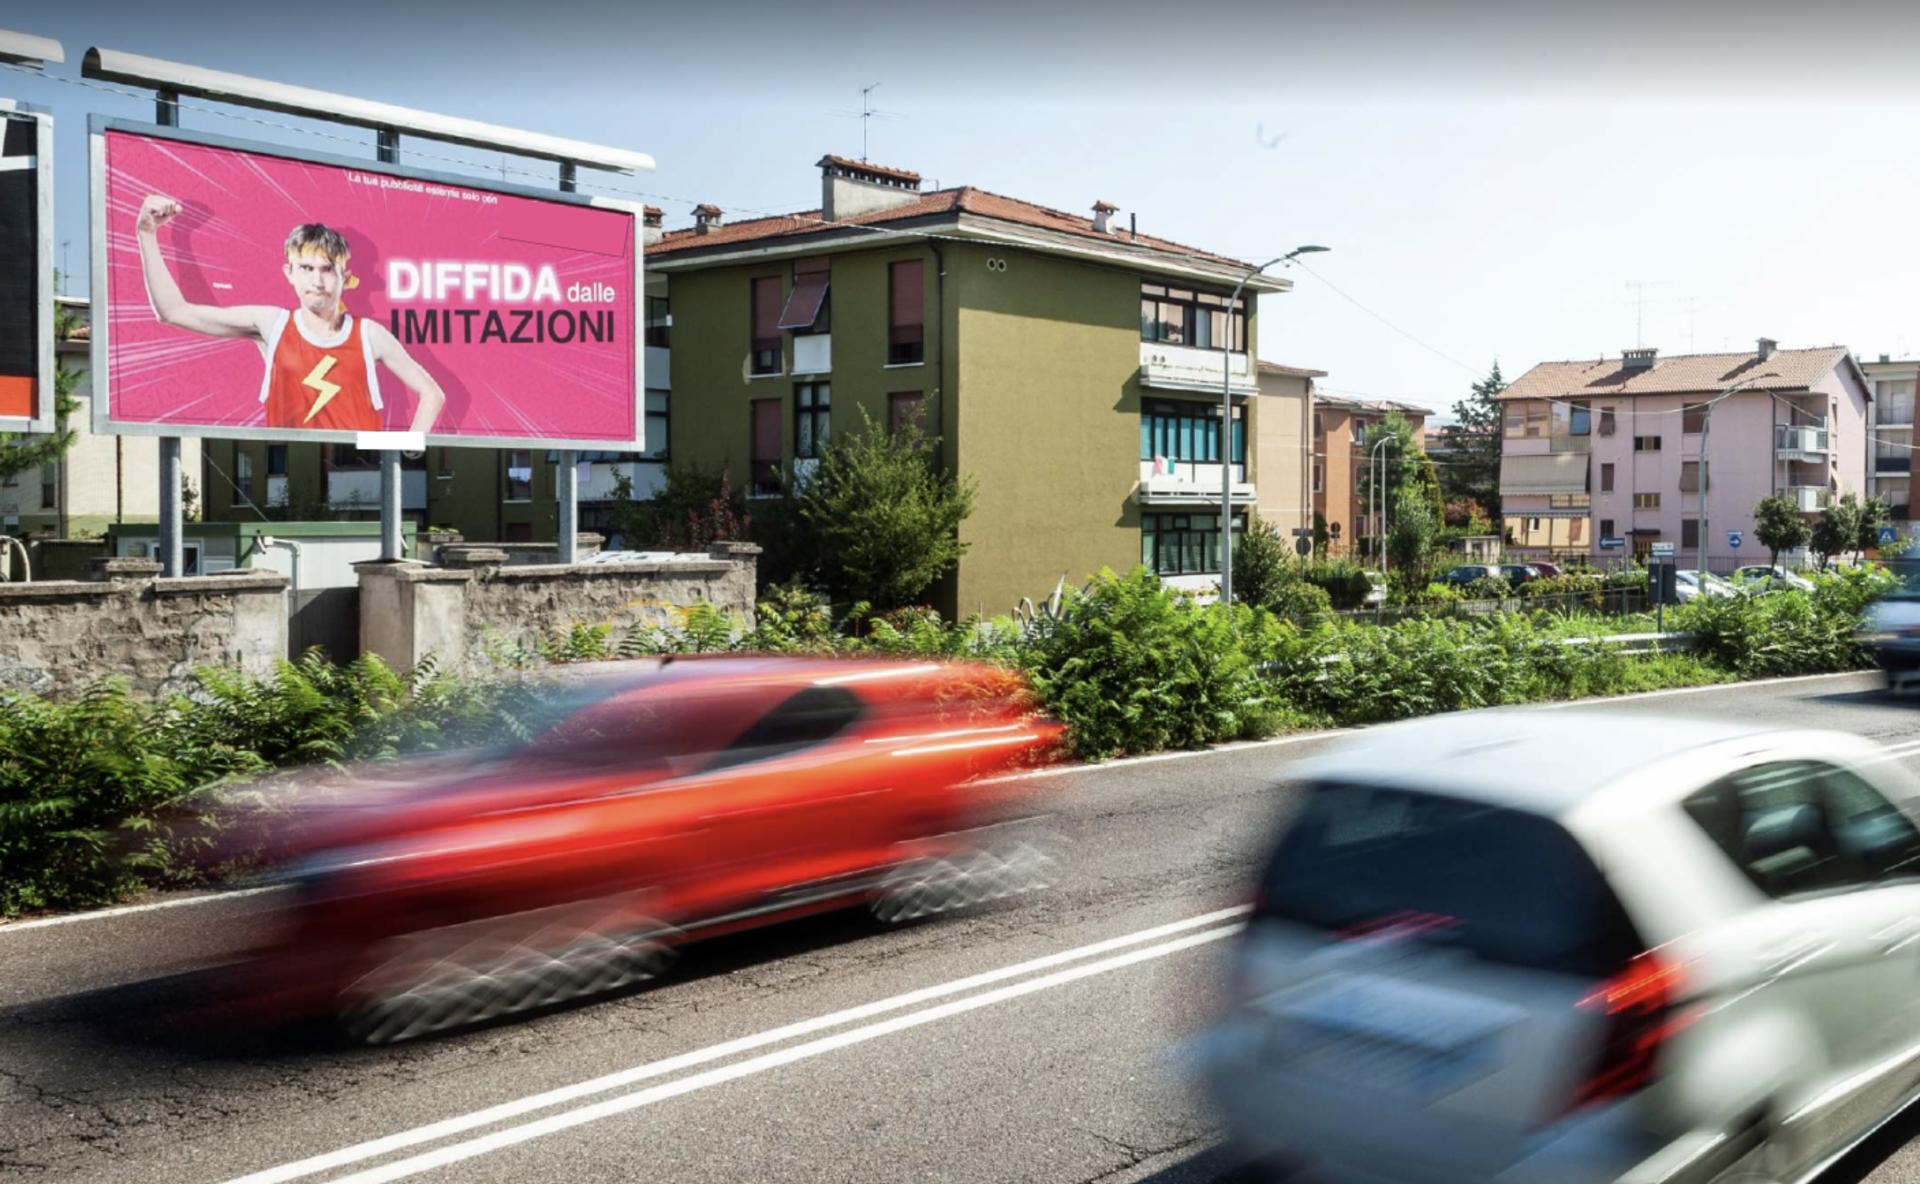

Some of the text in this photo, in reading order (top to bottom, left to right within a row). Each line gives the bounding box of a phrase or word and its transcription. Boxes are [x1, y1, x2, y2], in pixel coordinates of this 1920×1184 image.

[348, 172, 361, 183] La
[363, 174, 379, 186] tua
[462, 189, 480, 202] solo
[481, 193, 498, 204] con
[387, 260, 615, 303] DIFFIDA dalle
[390, 308, 614, 345] IMITAZIONI
